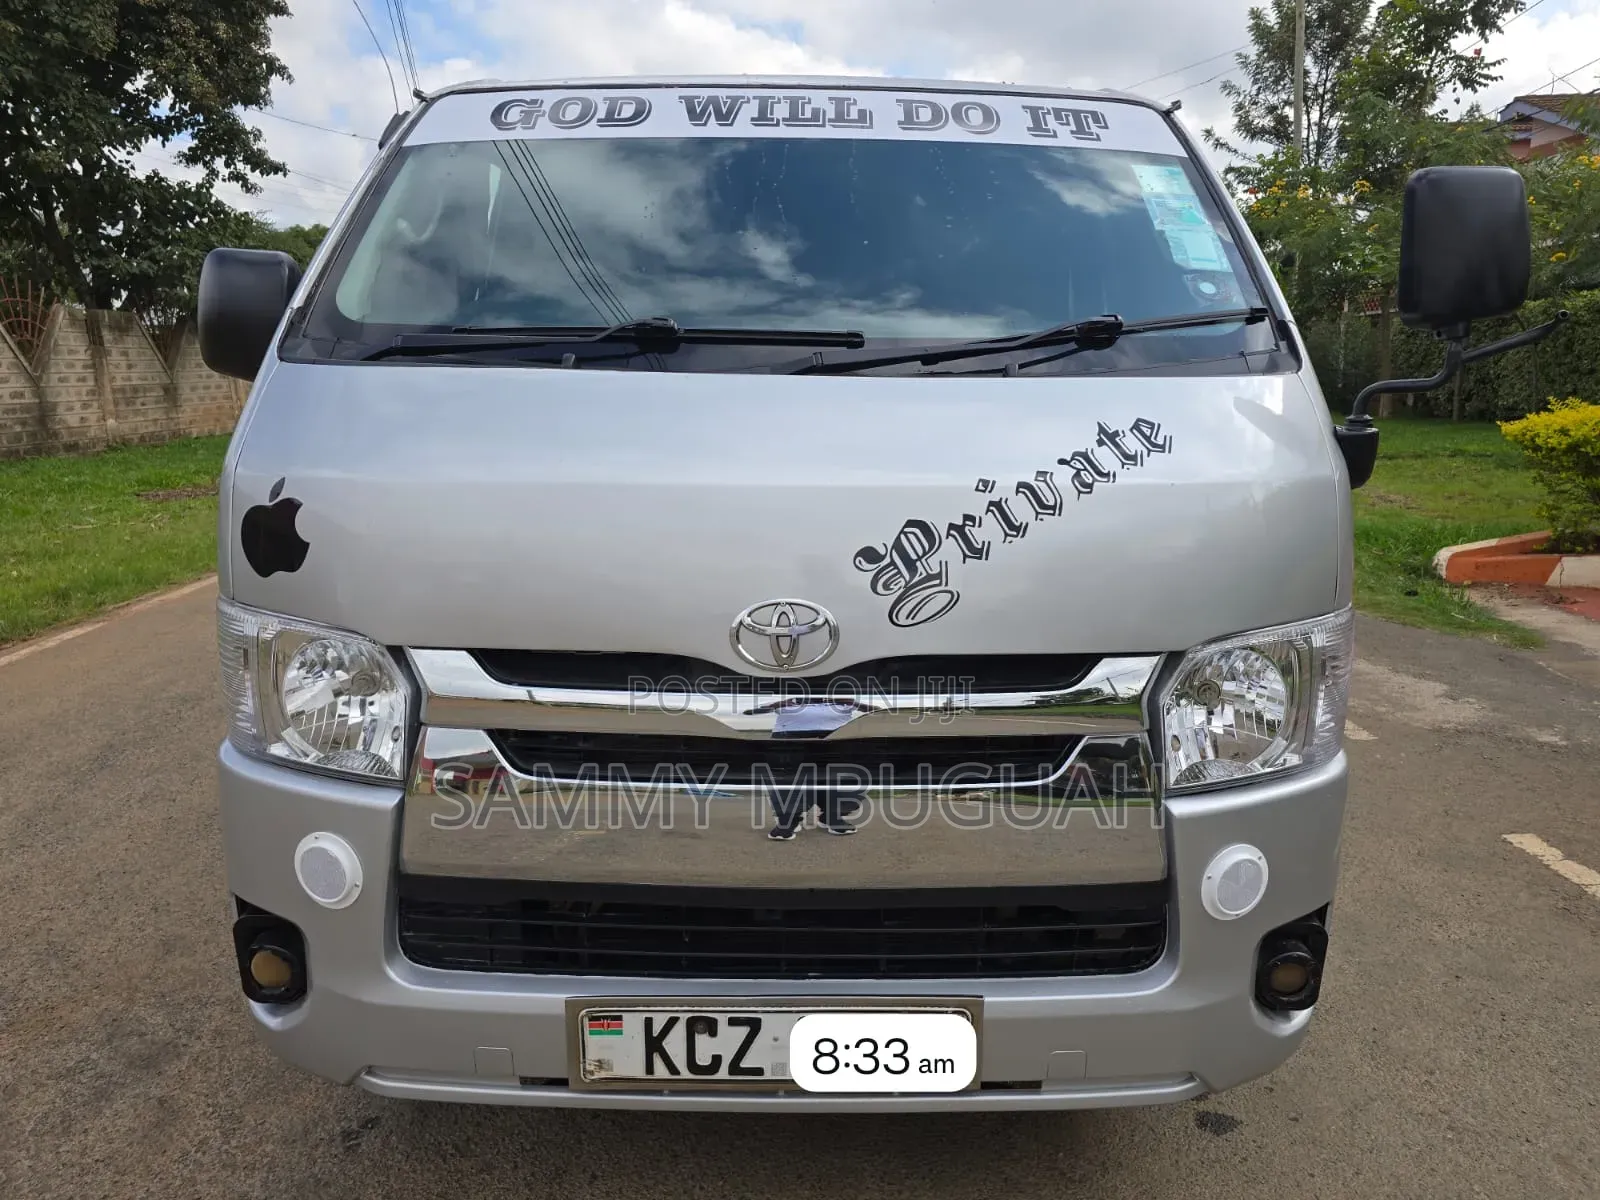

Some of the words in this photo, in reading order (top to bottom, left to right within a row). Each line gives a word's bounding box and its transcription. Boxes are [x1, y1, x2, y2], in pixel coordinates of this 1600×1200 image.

[490, 96, 653, 129] GOD
[679, 95, 873, 128] WILL
[896, 98, 1001, 134] DO
[1021, 105, 1109, 142] IT
[853, 417, 1173, 628] Private
[644, 1015, 765, 1076] KCZ
